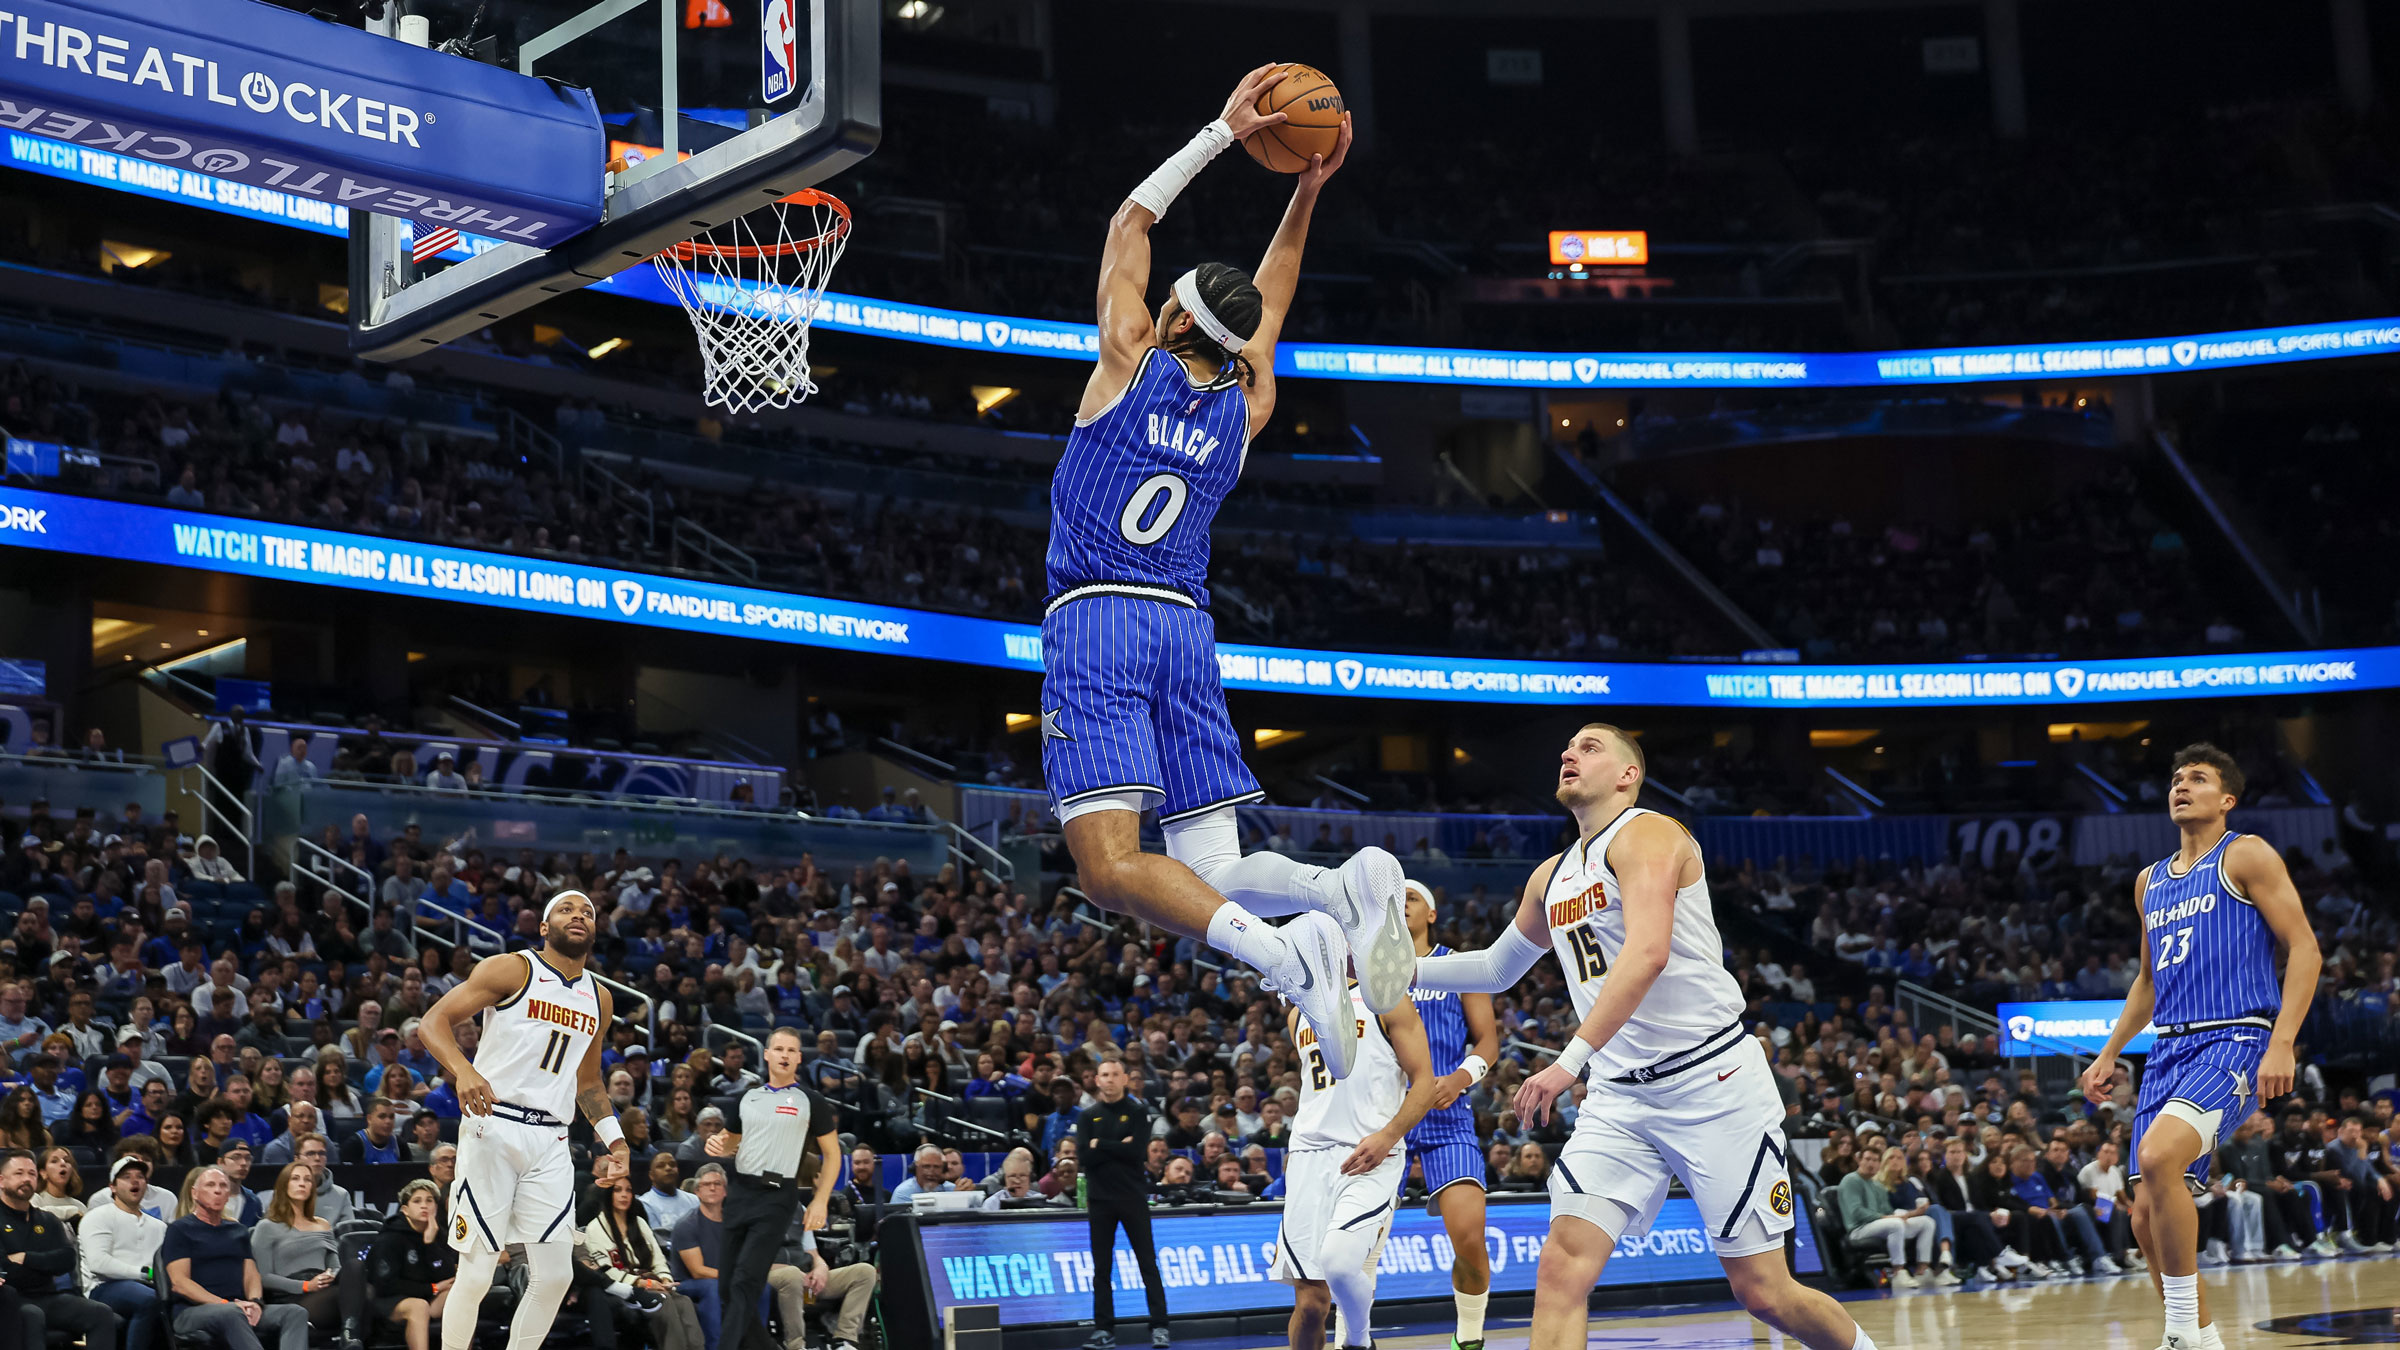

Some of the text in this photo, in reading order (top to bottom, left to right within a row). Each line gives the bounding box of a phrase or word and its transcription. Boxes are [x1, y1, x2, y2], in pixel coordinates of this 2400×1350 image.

[767, 70, 785, 95] NBA
[9, 134, 349, 229] WATCH THE MAGIC ALL SEASON LONG O
[834, 301, 862, 326] ALL
[862, 306, 919, 335] SEASON
[920, 315, 960, 341] LONG
[959, 320, 983, 343] ON
[1011, 328, 1084, 350] FANDUEL
[1294, 350, 1808, 381] WATCH THE MAGIC ALL SEASON LONG ON FANDUEL SPORTS NETWORK
[1877, 356, 1932, 379] WATCH
[1932, 354, 1962, 378] THE
[1962, 352, 2013, 375] MAGIC
[2014, 351, 2042, 373] ALL
[2042, 348, 2102, 372] SEASON
[2102, 346, 2145, 369] LONG
[2145, 345, 2170, 367] ON
[2199, 338, 2278, 361] FANDUEL
[2277, 331, 2341, 354] SPORTS
[1148, 413, 1221, 467] BLACK
[1119, 471, 1189, 547] 0
[172, 522, 910, 645] WATCH THE MAGIC ALL SEASON LONG ON FANDUEL SPORTS NETWORK
[1003, 633, 1043, 661] WAT
[1258, 656, 1305, 685] LONG
[1305, 660, 1332, 686] ON
[1365, 666, 1451, 690] FANDUEL
[1450, 670, 1519, 693] SPORTS
[1521, 673, 1611, 695] NETWORK
[1705, 661, 2358, 700] WATCH THE MAGIC ALL SEASON LONG ON FANDUEL SPORTS NETWORK
[1549, 881, 1608, 930] NUGGETS
[1565, 922, 1609, 984] 15
[2156, 925, 2195, 972] 23
[526, 998, 597, 1037] NUGGETS
[540, 1028, 572, 1076] 11
[1309, 1049, 1336, 1091] 2
[942, 1252, 1055, 1300] WATCH
[1053, 1251, 1095, 1294] TH
[1114, 1246, 1209, 1291] MGIC
[1213, 1243, 1264, 1286] ALL
